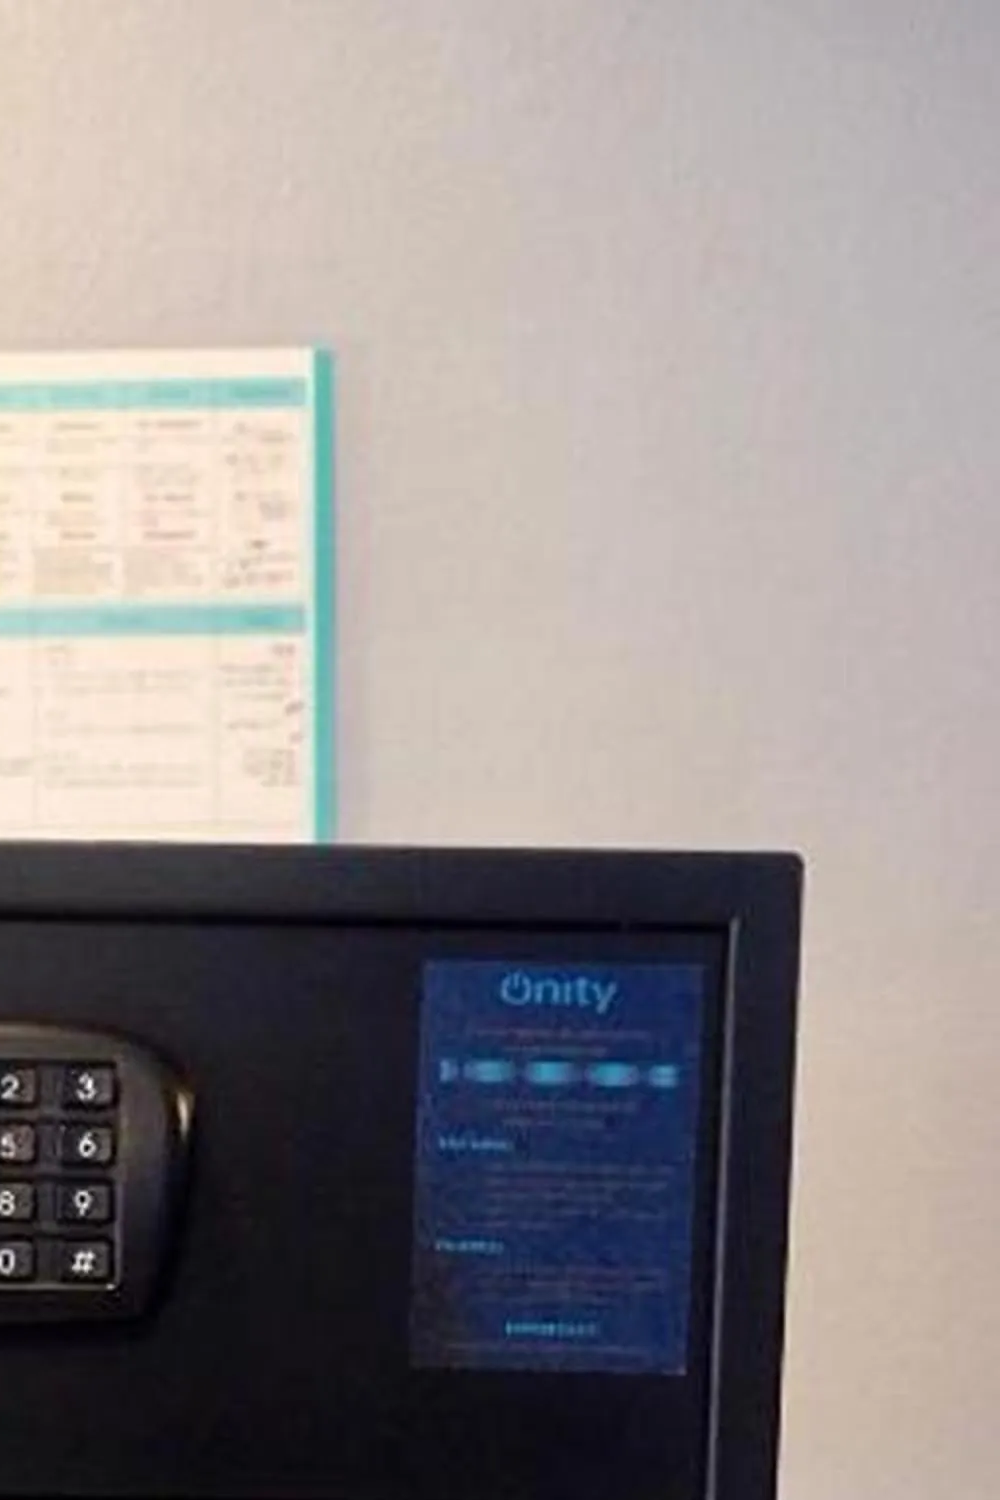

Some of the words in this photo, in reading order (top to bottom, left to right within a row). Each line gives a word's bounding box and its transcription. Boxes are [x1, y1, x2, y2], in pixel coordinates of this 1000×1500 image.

[501, 970, 617, 1013] Onity
[1, 1074, 20, 1099] 2
[77, 1073, 97, 1100] 3
[0, 1133, 16, 1159] 5
[79, 1132, 97, 1158] 6
[73, 1190, 92, 1217] 9
